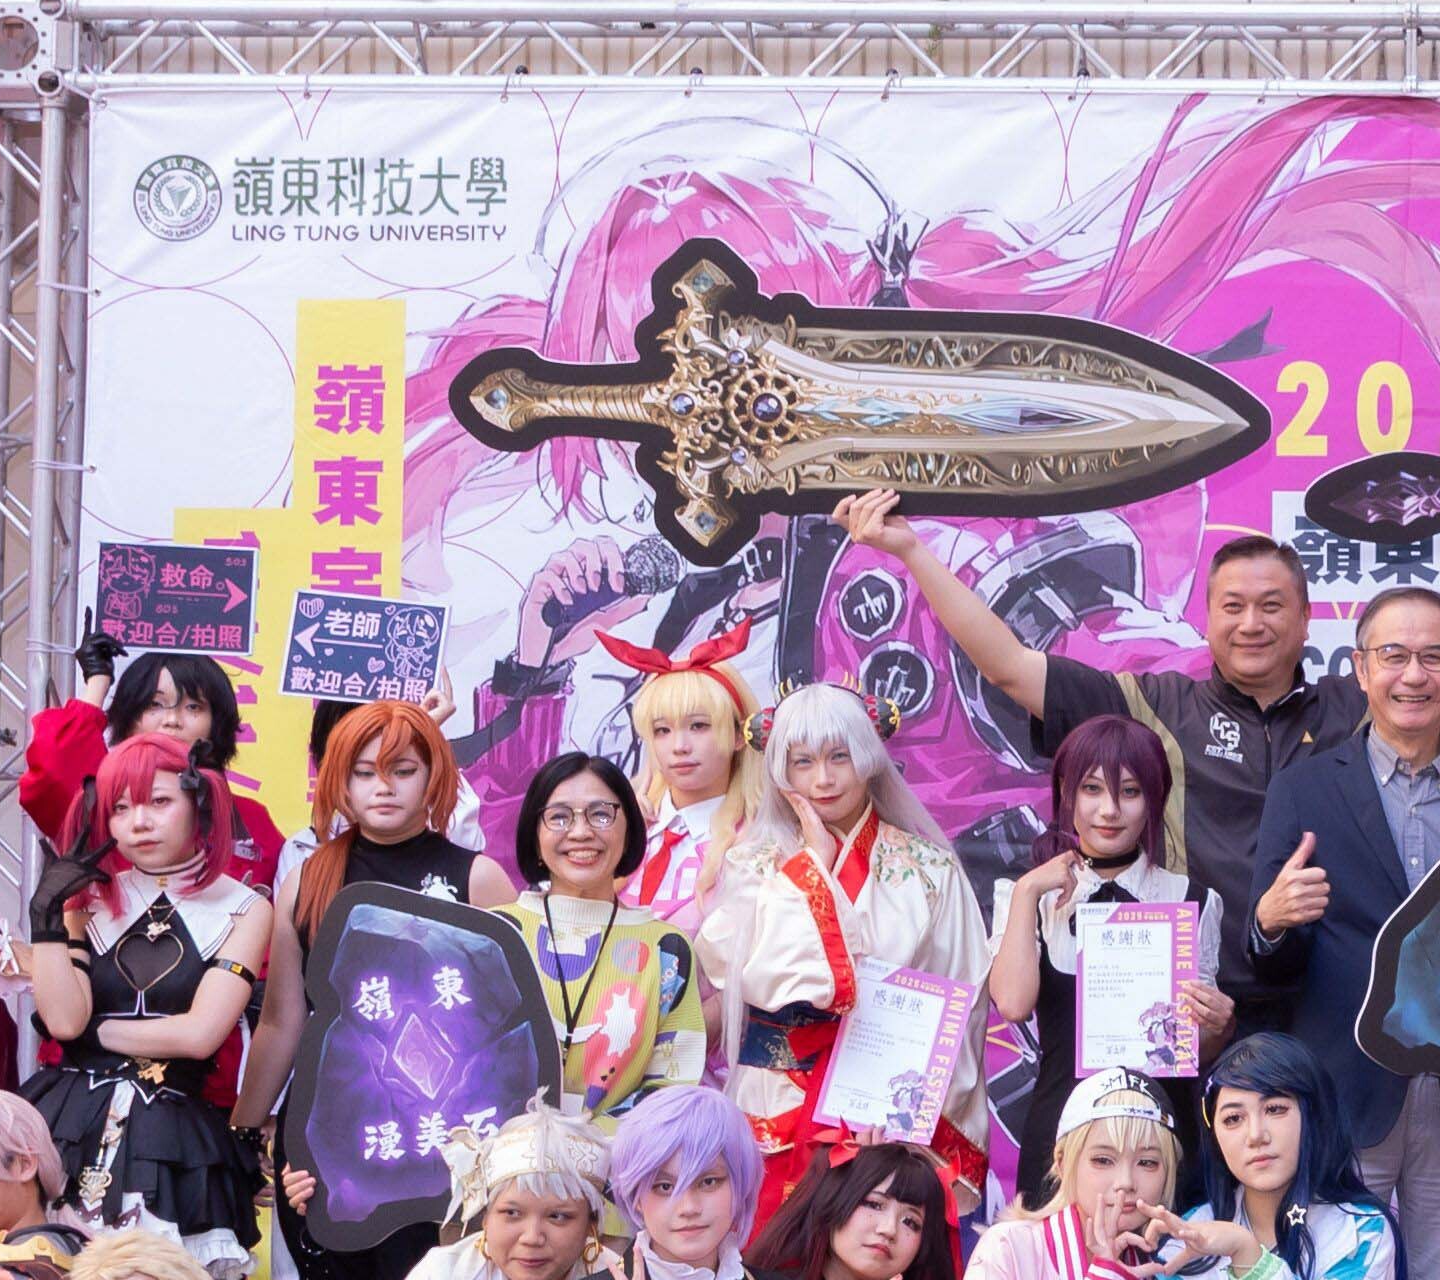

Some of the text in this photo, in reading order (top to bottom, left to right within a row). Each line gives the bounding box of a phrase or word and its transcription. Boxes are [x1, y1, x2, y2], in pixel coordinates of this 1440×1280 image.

[233, 156, 508, 217] 嶺東科技大學
[232, 224, 508, 241] LING TUNG UNIVERSITY
[101, 620, 244, 650] 歡迎合/拍照
[324, 607, 381, 640] 老師
[290, 666, 428, 704] 歡迎合/拍照
[1175, 907, 1194, 971] ANIME
[938, 986, 970, 1049] ANIME
[363, 1106, 499, 1161] 漫美石
